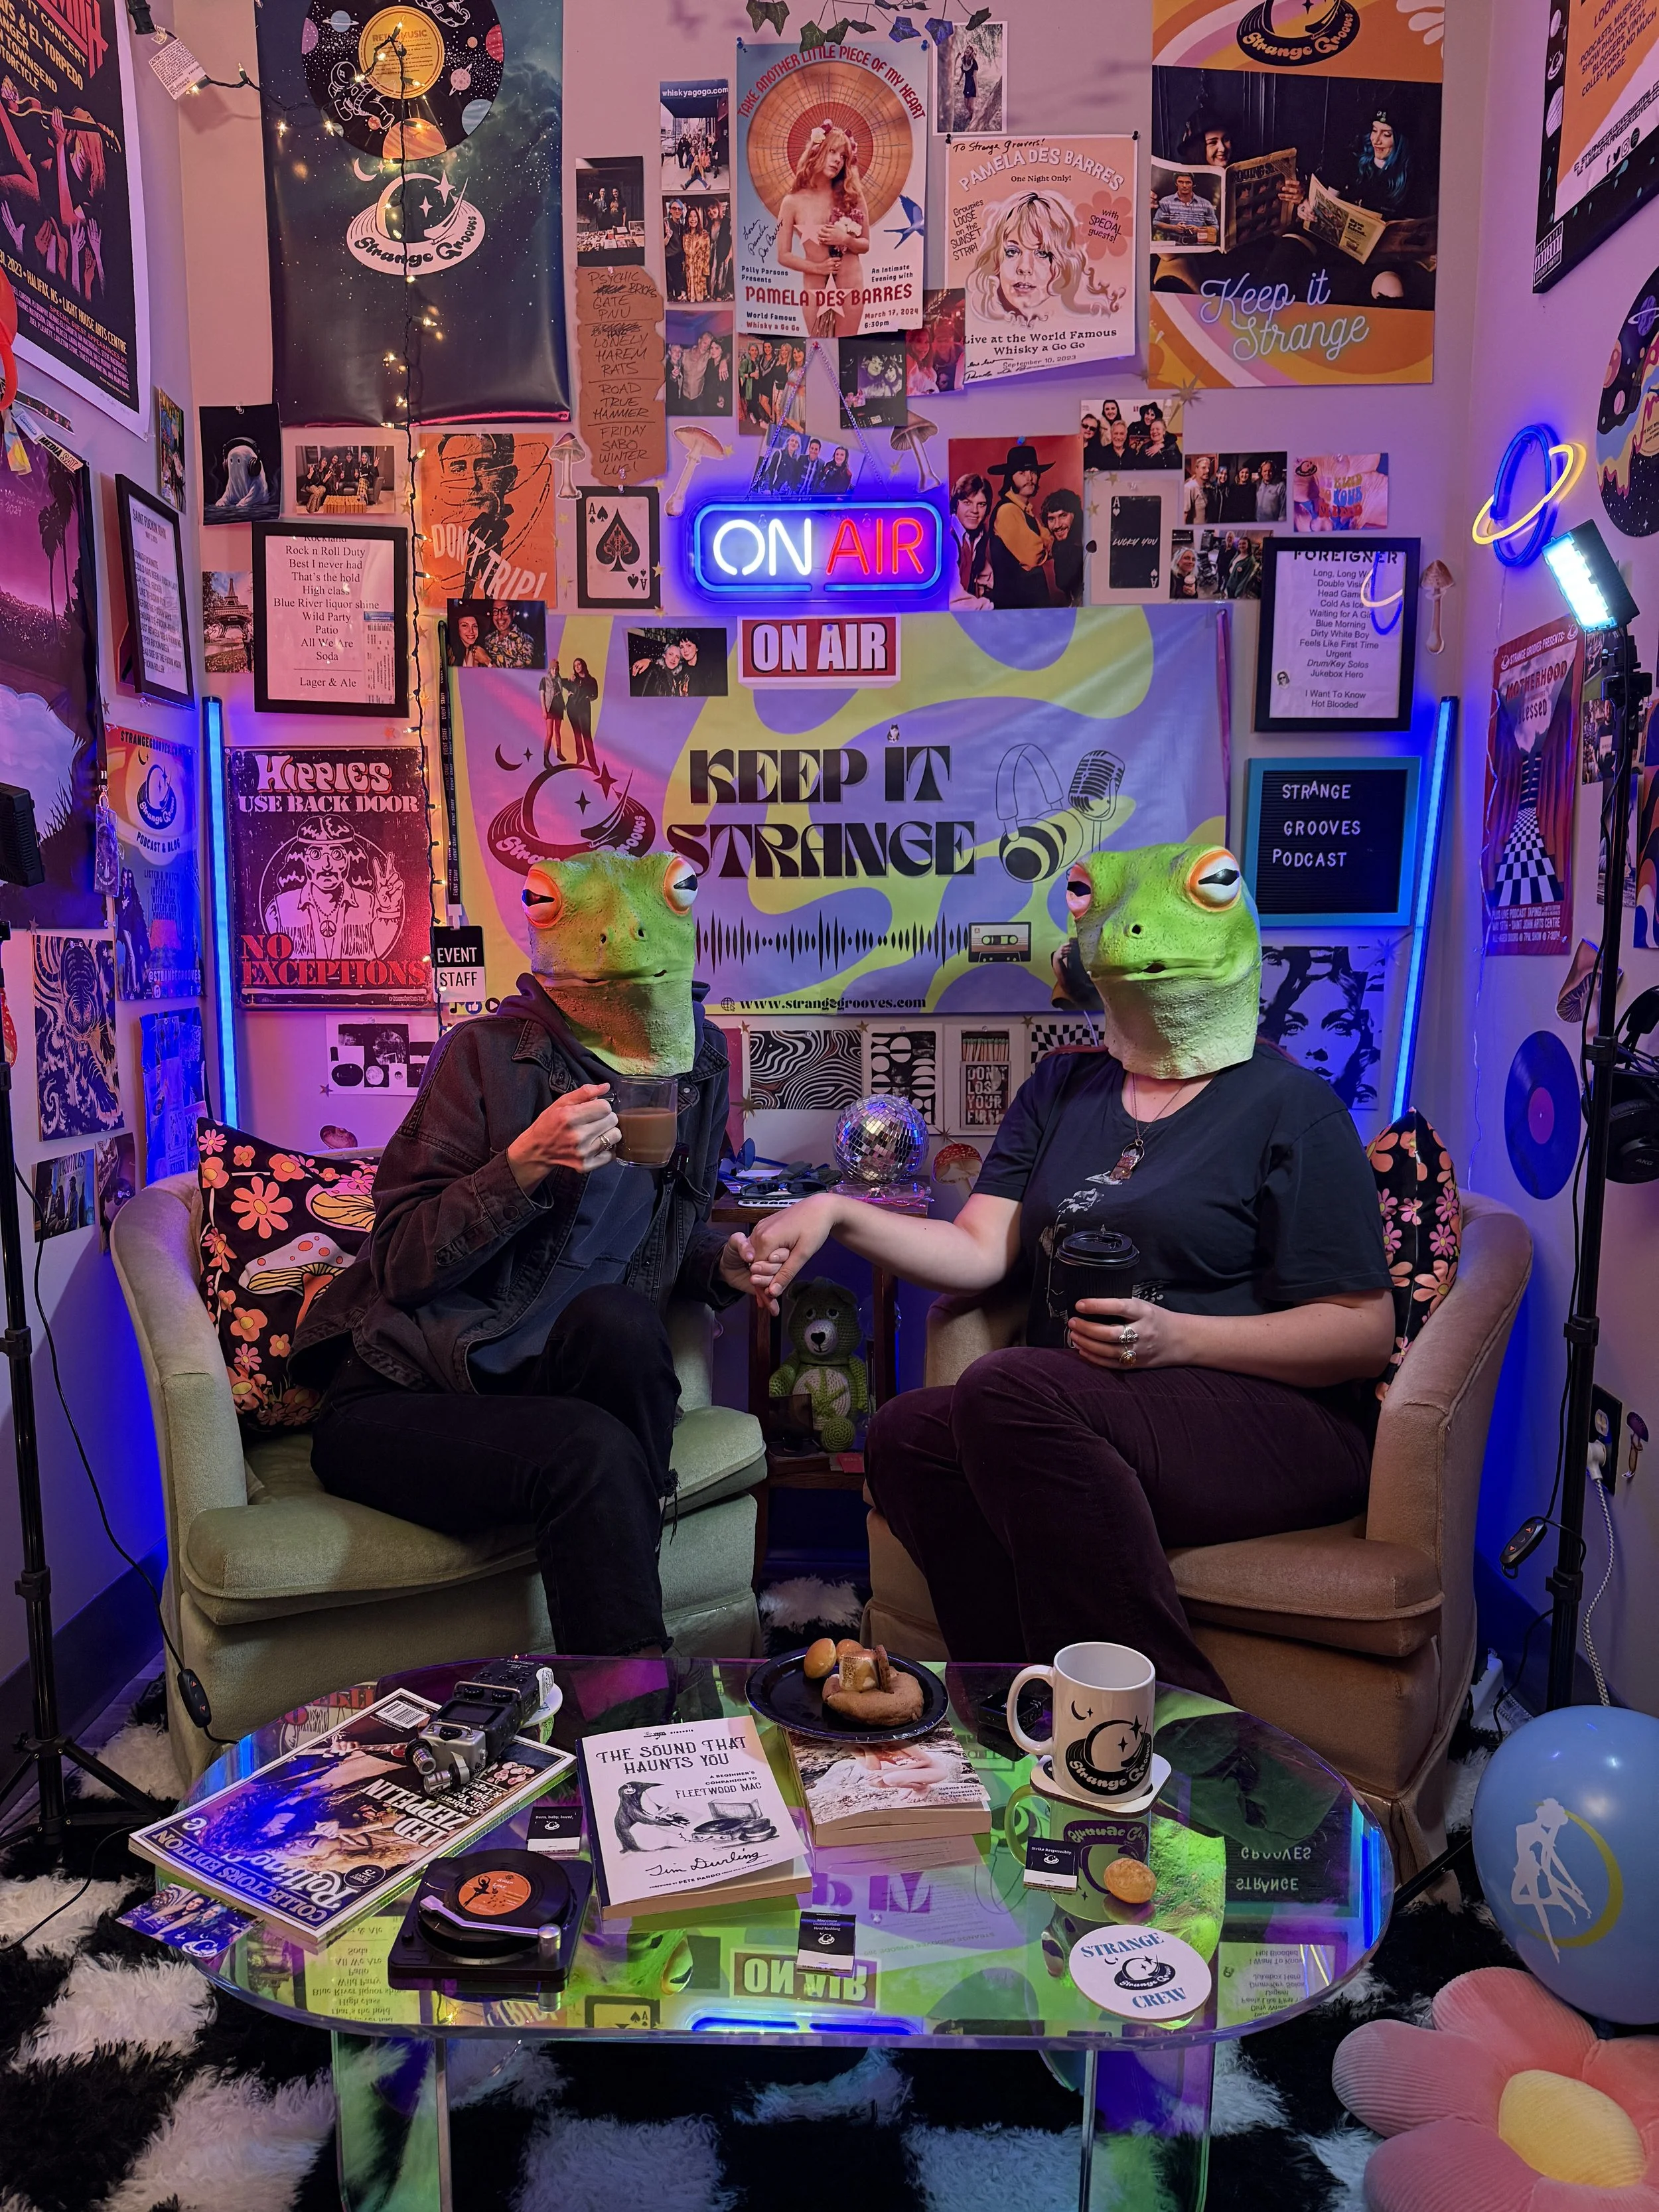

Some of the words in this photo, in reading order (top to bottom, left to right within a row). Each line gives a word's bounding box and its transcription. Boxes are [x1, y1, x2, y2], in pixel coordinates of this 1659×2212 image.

[40, 12, 88, 67] CONCERT
[1242, 33, 1313, 60] Strange
[5, 34, 57, 92] TOWNSEND
[43, 36, 83, 90] TORPEDO
[1607, 55, 1626, 82] MORE
[737, 92, 760, 118] TAKE
[757, 54, 800, 92] ANOTHER
[839, 45, 871, 66] PIECE
[871, 58, 887, 72] OF
[884, 67, 904, 86] MY
[899, 83, 927, 120] HEART
[1582, 52, 1620, 98] COLLECTORS
[662, 86, 729, 98] whiskyagogo.com
[959, 150, 1027, 192] PAMELA
[1029, 147, 1061, 164] DES
[1064, 149, 1124, 191] BARRES
[1028, 175, 1049, 183] Night
[1052, 175, 1072, 183] Only!
[953, 199, 983, 216] Groupies
[1102, 209, 1119, 220] with
[953, 210, 977, 228] LOOSE
[1089, 215, 1122, 235] SPECIAL
[950, 228, 981, 249] SUNSET
[1088, 228, 1117, 244] guests!
[354, 237, 433, 267] Strange
[952, 242, 979, 261] STRIP!
[881, 265, 910, 273] Intimate
[588, 271, 640, 287] PSYCHIC
[741, 275, 772, 283] Presents
[871, 273, 897, 283] Evening
[745, 286, 809, 307] PAMELA
[816, 290, 845, 307] DES
[851, 283, 912, 306] BARRES
[1200, 272, 1295, 325] Keep
[1307, 269, 1331, 306] it
[79, 309, 94, 332] HOUSE
[770, 313, 796, 322] Famous
[865, 311, 886, 320] March
[747, 321, 772, 331] Whisky
[864, 320, 889, 329] 6:30pm
[991, 334, 1003, 343] at
[1007, 333, 1027, 343] the
[1030, 332, 1066, 342] World
[1070, 329, 1117, 339] Famous
[1232, 315, 1370, 361] Strange
[993, 345, 1039, 355] Whisky
[601, 362, 638, 377] RATS
[599, 382, 641, 395] ROAD
[600, 425, 646, 439] FRIDAY
[39, 437, 63, 457] MEDIA
[599, 450, 650, 463] WINTER
[713, 518, 812, 576] ON
[826, 518, 924, 575] AIR
[1112, 537, 1139, 547] LUCKY
[1141, 537, 1158, 546] YOU
[286, 546, 309, 555] Rock
[322, 547, 340, 555] Roll
[344, 548, 365, 558] Duty
[289, 559, 309, 568] Best
[431, 523, 486, 577] DON'T
[479, 550, 547, 601] TRIP!
[292, 572, 321, 581] That's
[1337, 569, 1356, 579] Long
[303, 586, 325, 596] High
[274, 599, 295, 607] Blue
[298, 599, 323, 608] River
[326, 599, 352, 610] liquor
[303, 612, 325, 621] Wild
[328, 613, 351, 624] Party
[1309, 609, 1338, 619] Waiting
[315, 625, 338, 634] Patio
[1335, 621, 1366, 630] Morning
[1311, 629, 1328, 638] Dirty
[1354, 630, 1369, 639] Boy
[301, 638, 315, 647] All
[752, 623, 809, 672] ON
[818, 623, 887, 672] AIR
[1510, 649, 1526, 664] STRANGE
[1526, 640, 1542, 658] GROOVES
[1542, 632, 1565, 649] PRESENTS:
[317, 652, 338, 661] Soda
[300, 678, 325, 688] Lager
[340, 679, 356, 688] Ale
[1506, 660, 1567, 700] MOTHERHOOD
[690, 749, 868, 804] KEEP
[885, 746, 950, 801] IT
[1282, 780, 1351, 799] STRANGE
[238, 796, 282, 812] USE
[287, 796, 352, 812] BACK
[356, 796, 419, 812] DOOR
[1283, 820, 1360, 836] GROOVES
[137, 831, 160, 853] PODCAST
[667, 821, 975, 877] STRANGE
[1272, 848, 1347, 867] PODCAST
[241, 934, 291, 959] NO
[437, 947, 477, 963] EVENT
[242, 962, 425, 986] EXCEPTIONS
[439, 972, 477, 987] STAFF
[740, 997, 926, 1011] www.strangegrooves.com
[596, 1748, 634, 1763] THE
[701, 1736, 747, 1752] THAT
[624, 1757, 694, 1775] HAUNTS
[1069, 1761, 1127, 1791] Strange
[676, 1785, 737, 1799] FLEETWOOD
[359, 1779, 472, 1829] ZEPPELIN
[393, 1817, 449, 1847] LED
[1080, 1933, 1165, 1958] STRANGE
[1132, 1987, 1187, 2008] CREW
